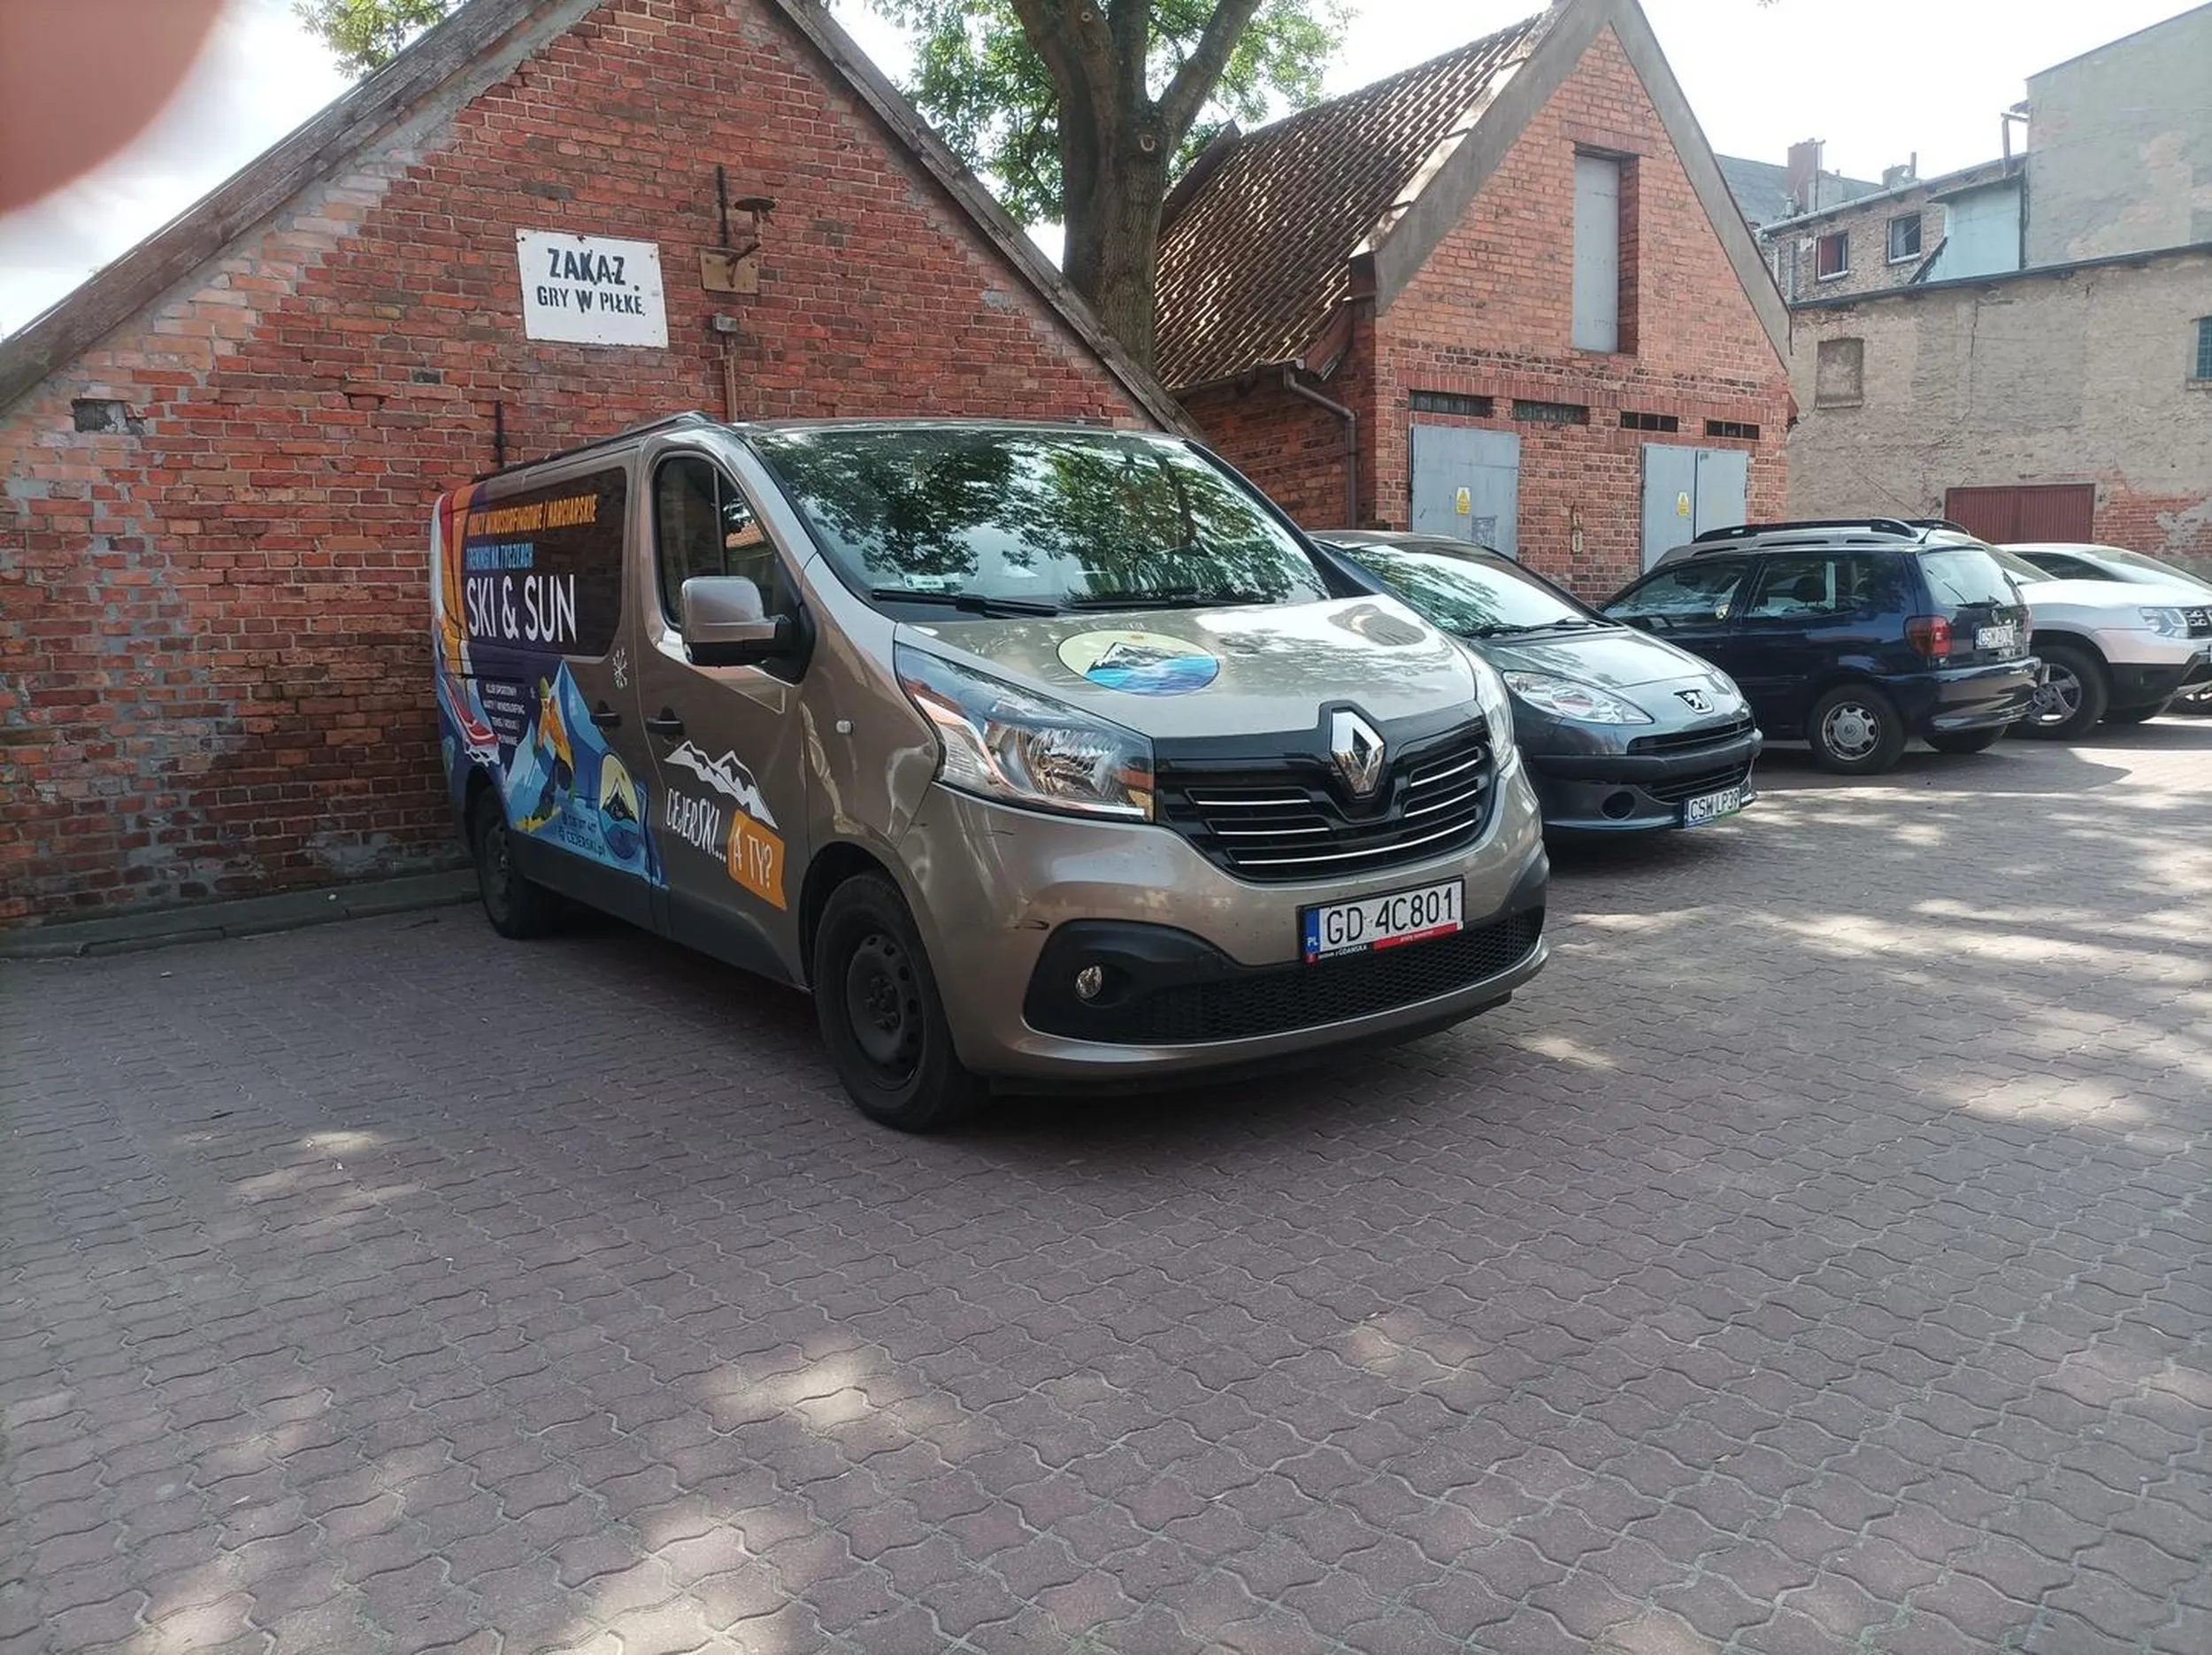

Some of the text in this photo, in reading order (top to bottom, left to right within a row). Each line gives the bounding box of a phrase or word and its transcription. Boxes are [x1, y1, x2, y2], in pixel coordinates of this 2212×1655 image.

[547, 248, 626, 286] ZAKAZ
[536, 285, 569, 308] GRY
[575, 289, 593, 313] W
[466, 573, 577, 643] SKI & SUN
[733, 825, 742, 872] A
[747, 834, 773, 889] TY?
[1327, 887, 1453, 945] GD 4C801
